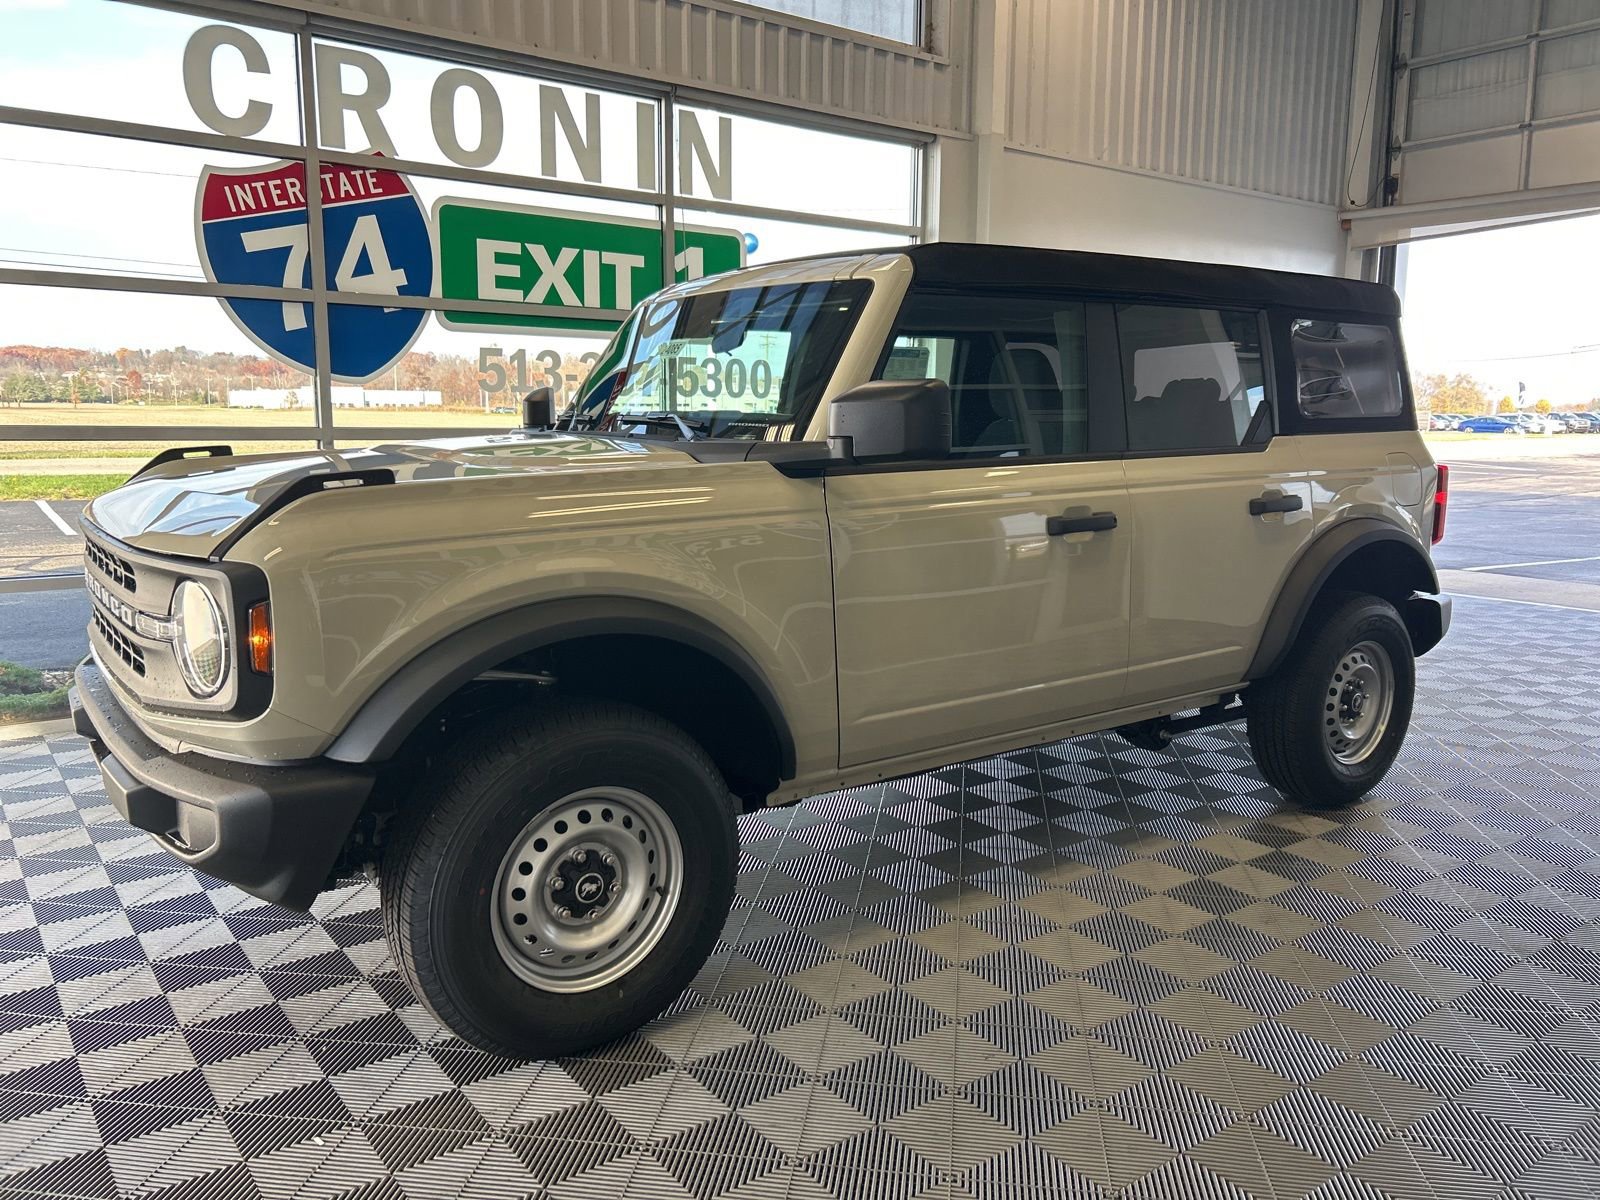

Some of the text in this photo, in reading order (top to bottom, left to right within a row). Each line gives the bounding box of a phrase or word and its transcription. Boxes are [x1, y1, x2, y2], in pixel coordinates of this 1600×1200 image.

[183, 25, 732, 201] CRONIN
[224, 170, 383, 212] INTERTATE
[240, 215, 408, 331] 74
[476, 237, 704, 310] EXIT 1
